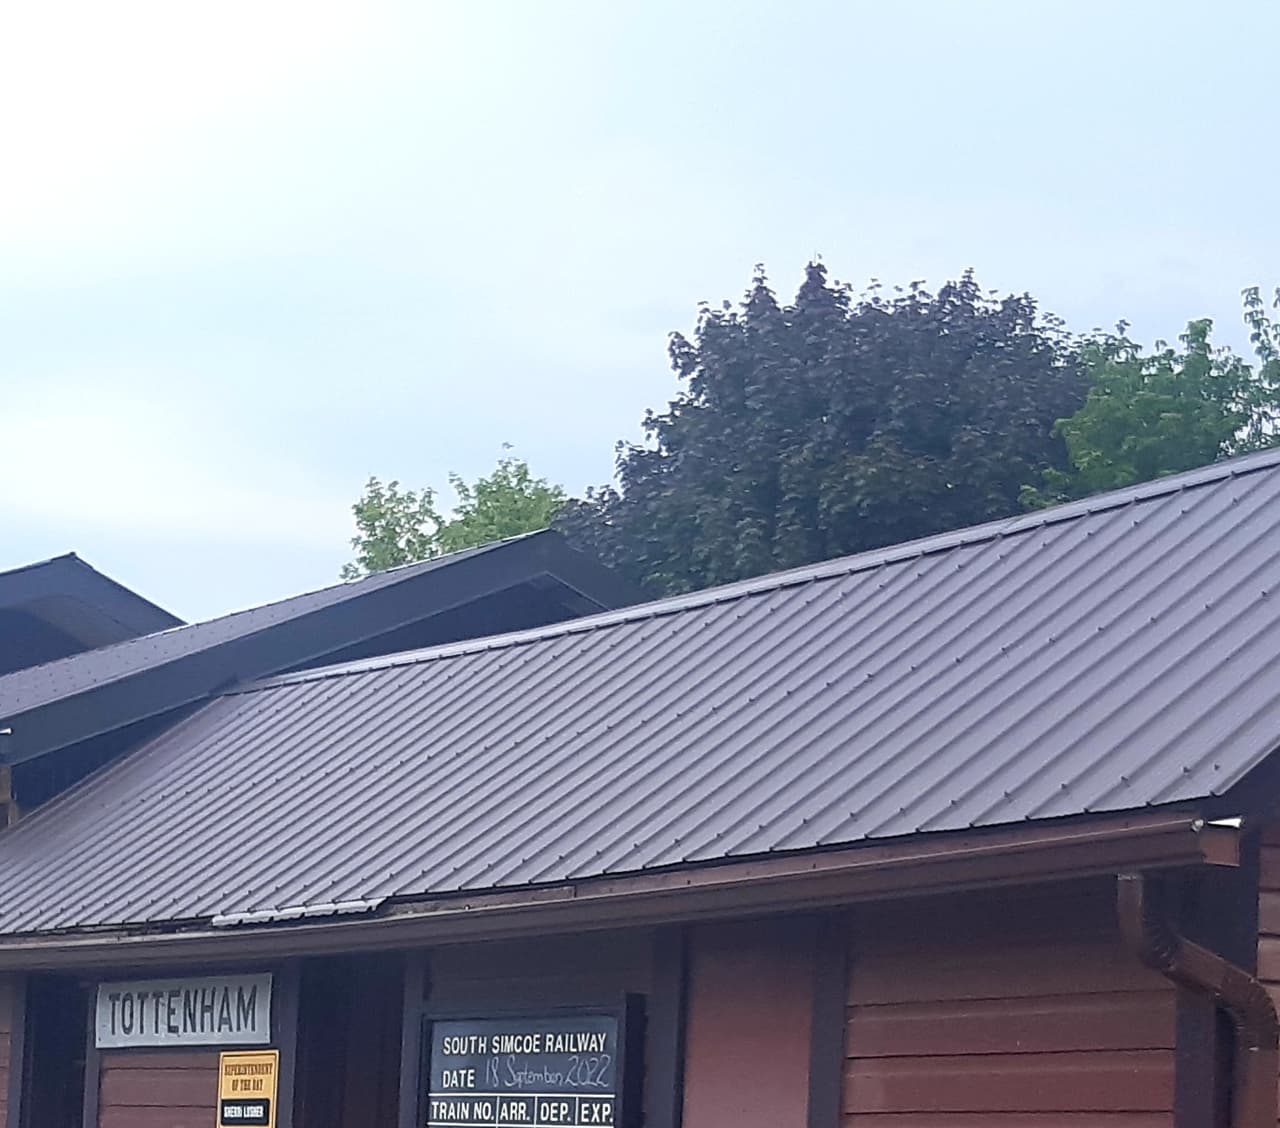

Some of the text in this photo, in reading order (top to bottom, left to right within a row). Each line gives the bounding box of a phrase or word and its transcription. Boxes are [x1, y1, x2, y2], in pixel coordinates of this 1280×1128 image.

[108, 984, 258, 1036] TOTTENHAM
[443, 1032, 607, 1055] SOUTH SIMCOE RAILWAY
[442, 1069, 475, 1088] DATE
[485, 1056, 499, 1088] 18
[564, 1054, 611, 1087] 2022
[431, 1101, 494, 1121] TRAIN NO.
[500, 1102, 530, 1121] ARR.
[540, 1102, 570, 1122] DEP.
[581, 1103, 614, 1123] EXP.
